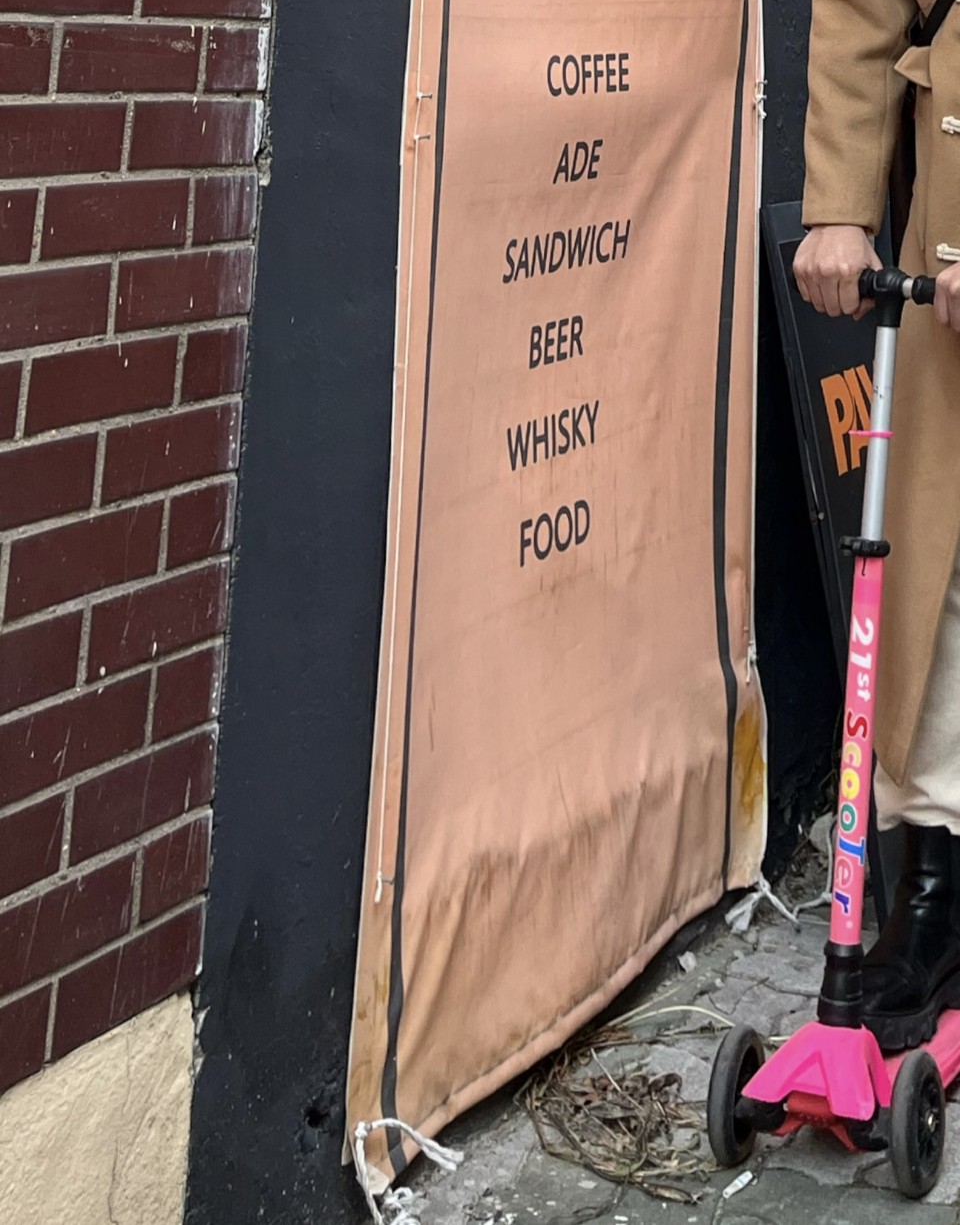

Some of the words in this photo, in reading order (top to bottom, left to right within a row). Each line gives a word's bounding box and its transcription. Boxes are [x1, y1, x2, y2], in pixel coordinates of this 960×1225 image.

[547, 52, 630, 97] COFFEE
[552, 138, 604, 185] ADE
[502, 218, 632, 284] SANDWICH
[528, 314, 584, 370] BEER
[506, 399, 600, 472] WHISKY
[519, 499, 591, 568] FOOD
[850, 617, 875, 703] 21st
